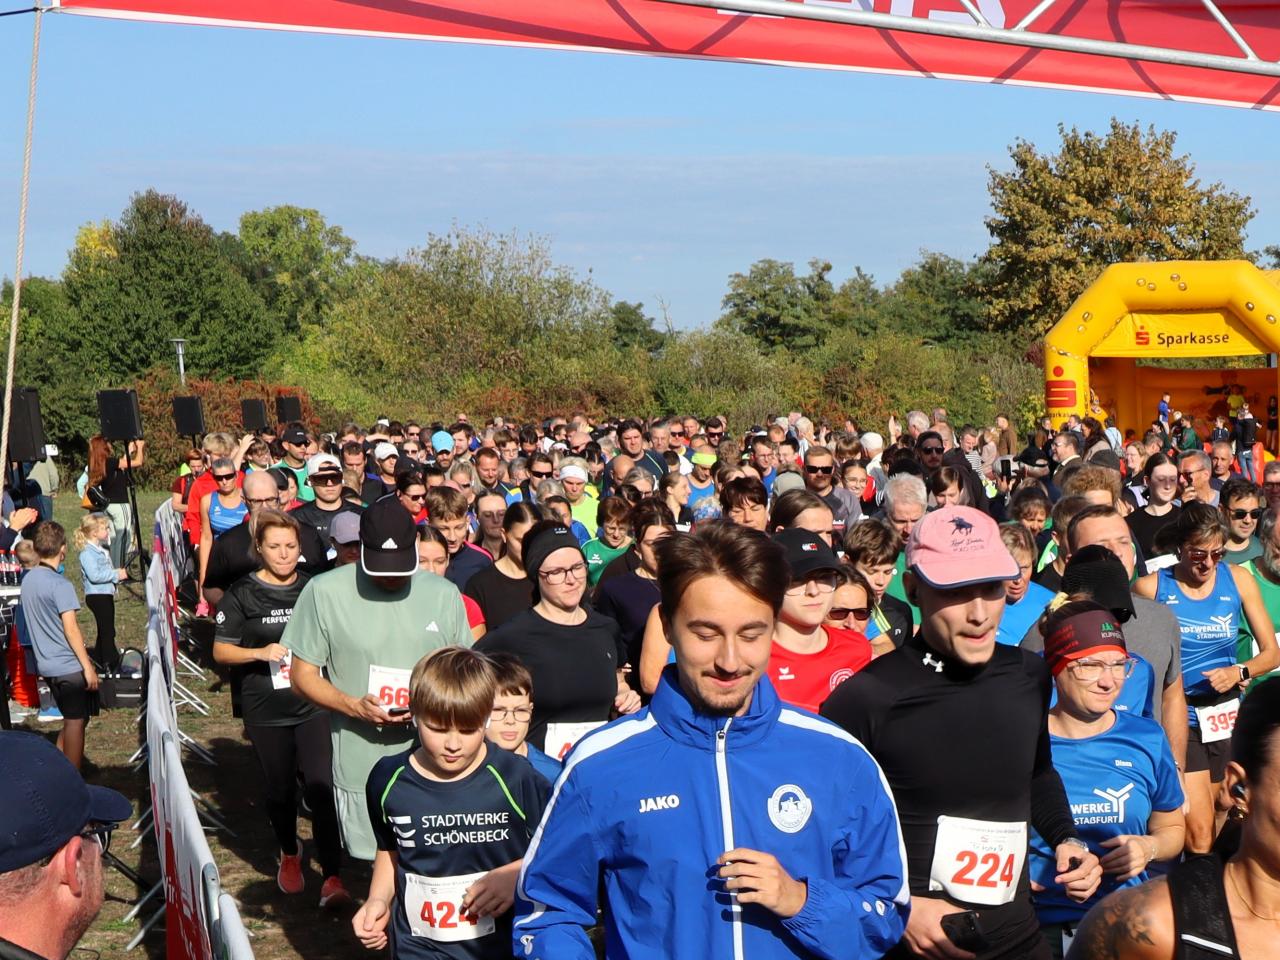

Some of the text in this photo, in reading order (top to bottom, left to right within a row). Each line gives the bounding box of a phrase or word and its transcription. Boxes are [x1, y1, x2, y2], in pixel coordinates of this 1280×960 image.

[1157, 331, 1229, 347] Sparkasse
[638, 794, 680, 813] JAKO
[421, 812, 510, 828] STADTWERKE
[423, 828, 510, 846] SCHÖNEBECK
[951, 850, 1015, 888] 224
